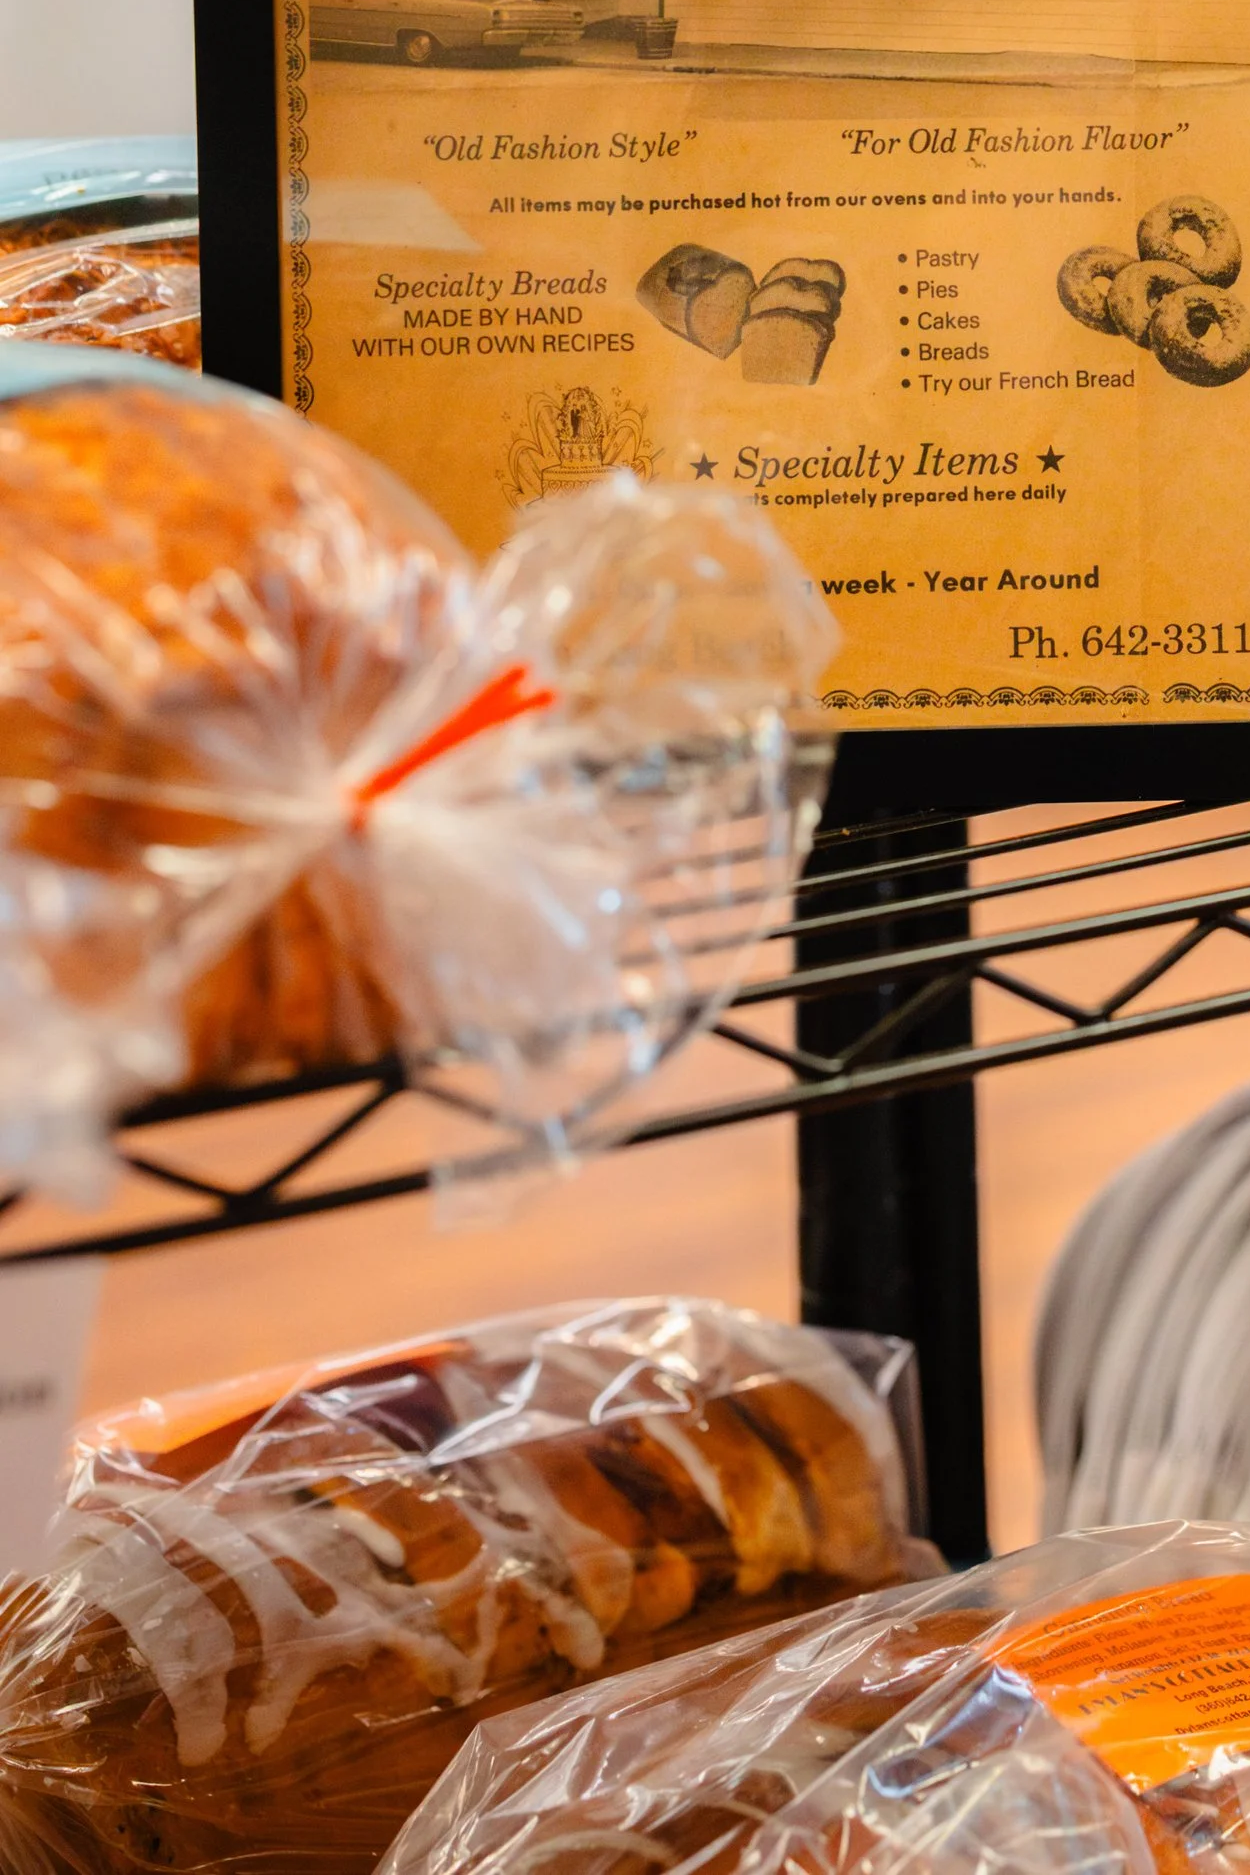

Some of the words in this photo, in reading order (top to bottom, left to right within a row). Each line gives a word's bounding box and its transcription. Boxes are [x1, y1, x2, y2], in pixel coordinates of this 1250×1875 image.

[491, 135, 600, 159] Fashion
[909, 129, 956, 153] Old
[964, 128, 1073, 152] Fashion
[490, 197, 514, 212] All
[521, 198, 571, 212] items
[577, 201, 615, 215] may
[622, 195, 644, 211] be
[650, 193, 745, 214] purchased
[752, 193, 781, 208] hot
[787, 192, 830, 207] from
[836, 196, 866, 206] our
[872, 195, 926, 206] ovens
[932, 189, 966, 204] and
[972, 190, 1006, 204] into
[1013, 193, 1054, 207] your
[1060, 187, 1121, 202] hands.
[916, 250, 979, 270] Pastry
[375, 272, 503, 304] Specialty
[511, 269, 606, 295] Breads
[918, 281, 958, 298] Pies
[404, 309, 472, 328] MADE
[480, 308, 509, 326] BY
[517, 307, 582, 325] HAND
[918, 312, 979, 330] Cakes
[352, 338, 413, 357] WITH
[421, 337, 470, 356] OUR
[477, 335, 534, 354] OWN
[543, 333, 634, 352] RECIPES
[919, 342, 989, 361] Breads
[919, 375, 952, 395] Try
[959, 378, 992, 391] our
[1000, 371, 1068, 389] French
[1077, 369, 1134, 387] Bread
[734, 445, 904, 487] Specialty
[913, 443, 1018, 476] Items
[775, 488, 877, 508] completely
[883, 486, 967, 507] prepared
[974, 486, 1016, 501] here
[1022, 484, 1066, 503] daily
[821, 571, 896, 594] week
[924, 571, 988, 592] Year
[998, 565, 1099, 590] Around
[1009, 626, 1068, 658] Ph.
[1174, 1685, 1209, 1703] Long
